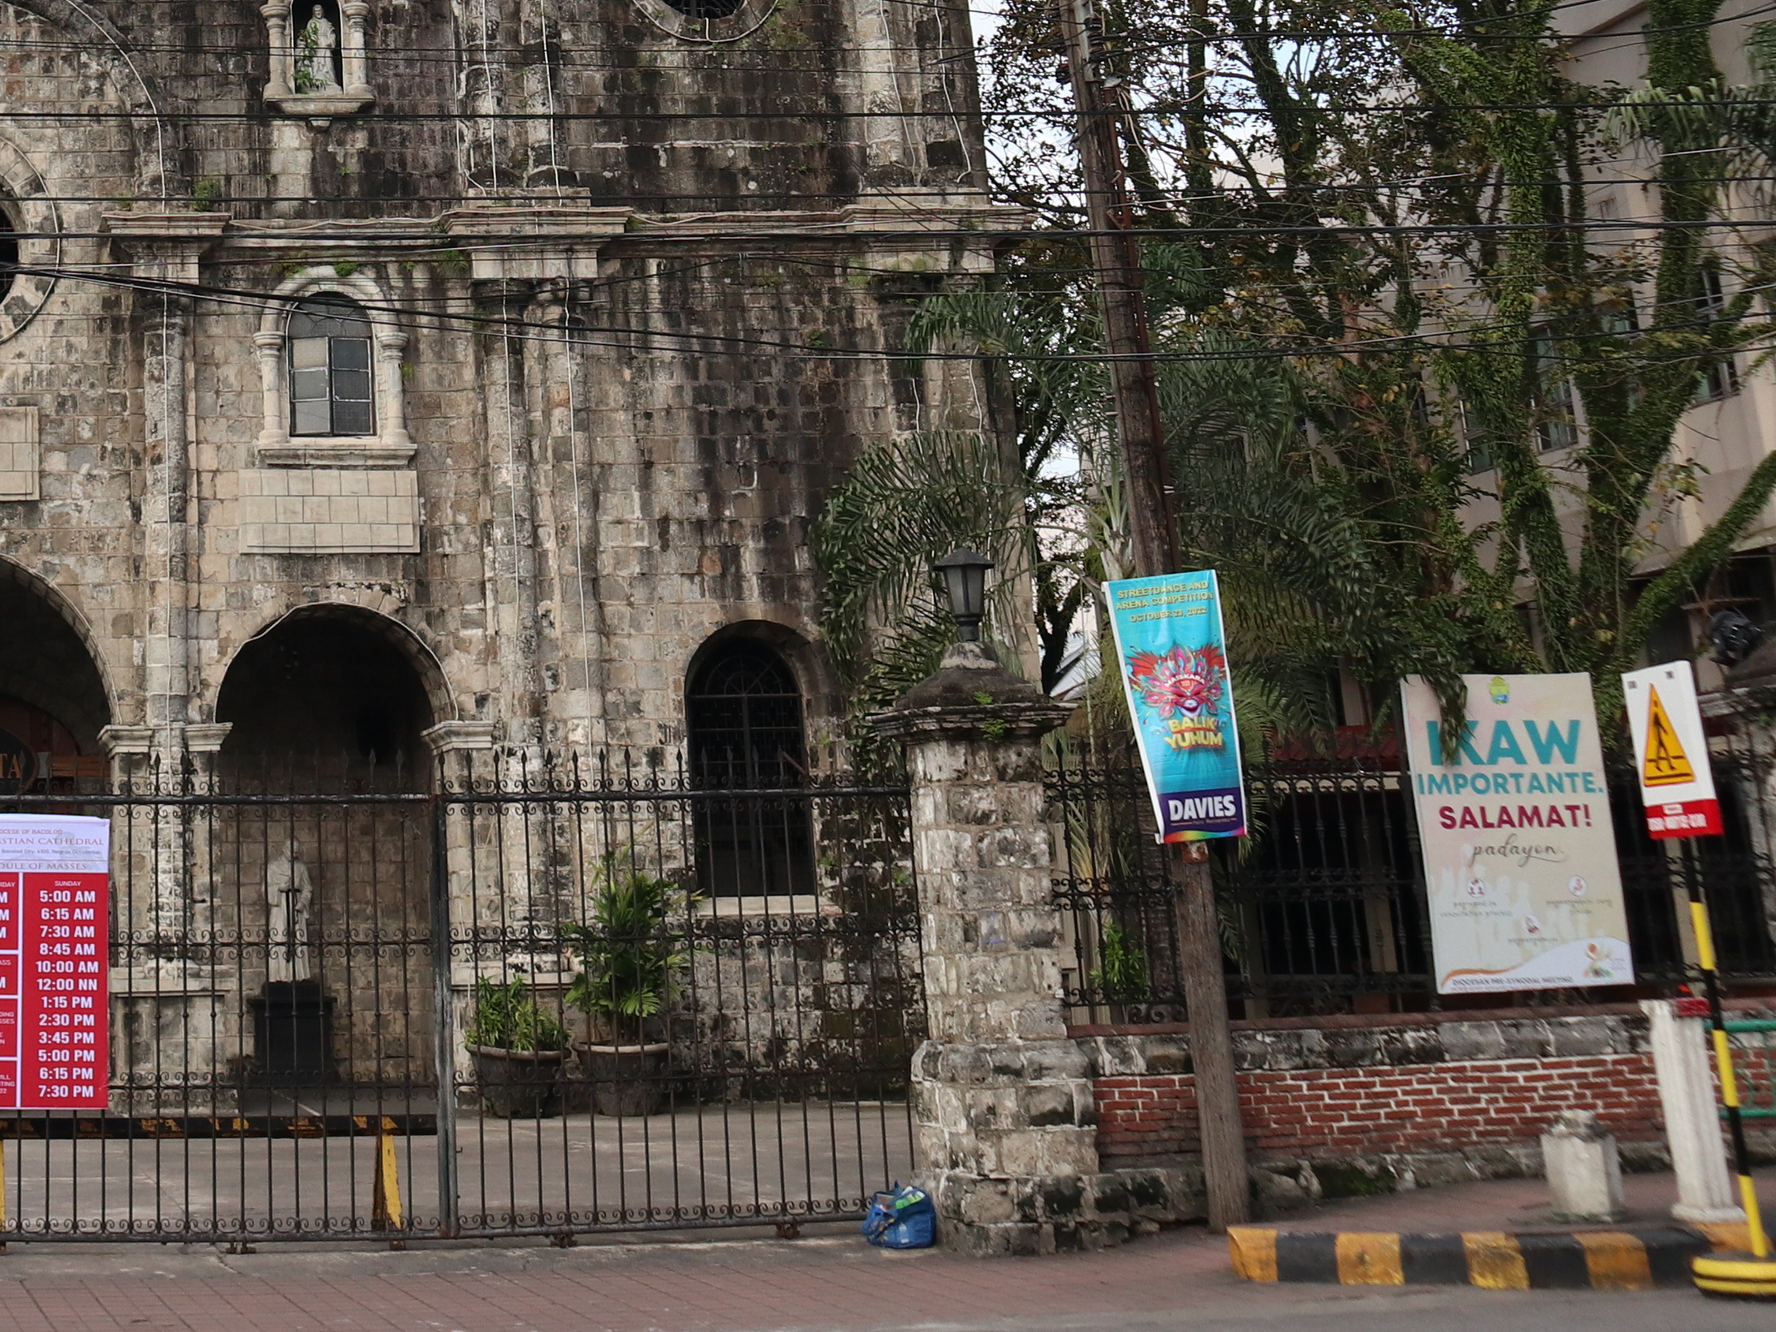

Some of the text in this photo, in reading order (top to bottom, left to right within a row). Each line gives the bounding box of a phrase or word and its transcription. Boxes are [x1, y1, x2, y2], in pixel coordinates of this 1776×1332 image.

[1117, 581, 1209, 599] STREETDANCE AND
[1116, 592, 1213, 611] ARENA COMPETITION
[1130, 611, 1171, 622] OCTOBER
[1187, 607, 1207, 615] 2022
[1168, 716, 1217, 732] BALIK
[1164, 730, 1222, 750] YUHUM
[1426, 720, 1580, 766] IKAW
[1417, 772, 1604, 795] IMPORTANTE.
[1168, 795, 1236, 821] DAVIES
[1440, 804, 1592, 830] SALAMAT!
[38, 837, 104, 845] CATHEDRAL
[47, 862, 87, 870] MASSES
[40, 890, 96, 902] 5:00 AM
[41, 908, 94, 920] 6:15 AM
[40, 926, 94, 938] 7:30 AM
[39, 943, 95, 955] 8:45 AM
[36, 961, 99, 973] 10:00 AM
[37, 978, 97, 990] 12:00 NN
[41, 996, 93, 1008] 1:15 PM
[39, 1014, 95, 1026] 2:30 PM
[39, 1032, 94, 1044] 3:45 PM
[38, 1050, 95, 1062] 5:00 PM
[39, 1067, 93, 1079] 6:15 PM
[38, 1085, 94, 1097] 7:30 PM
